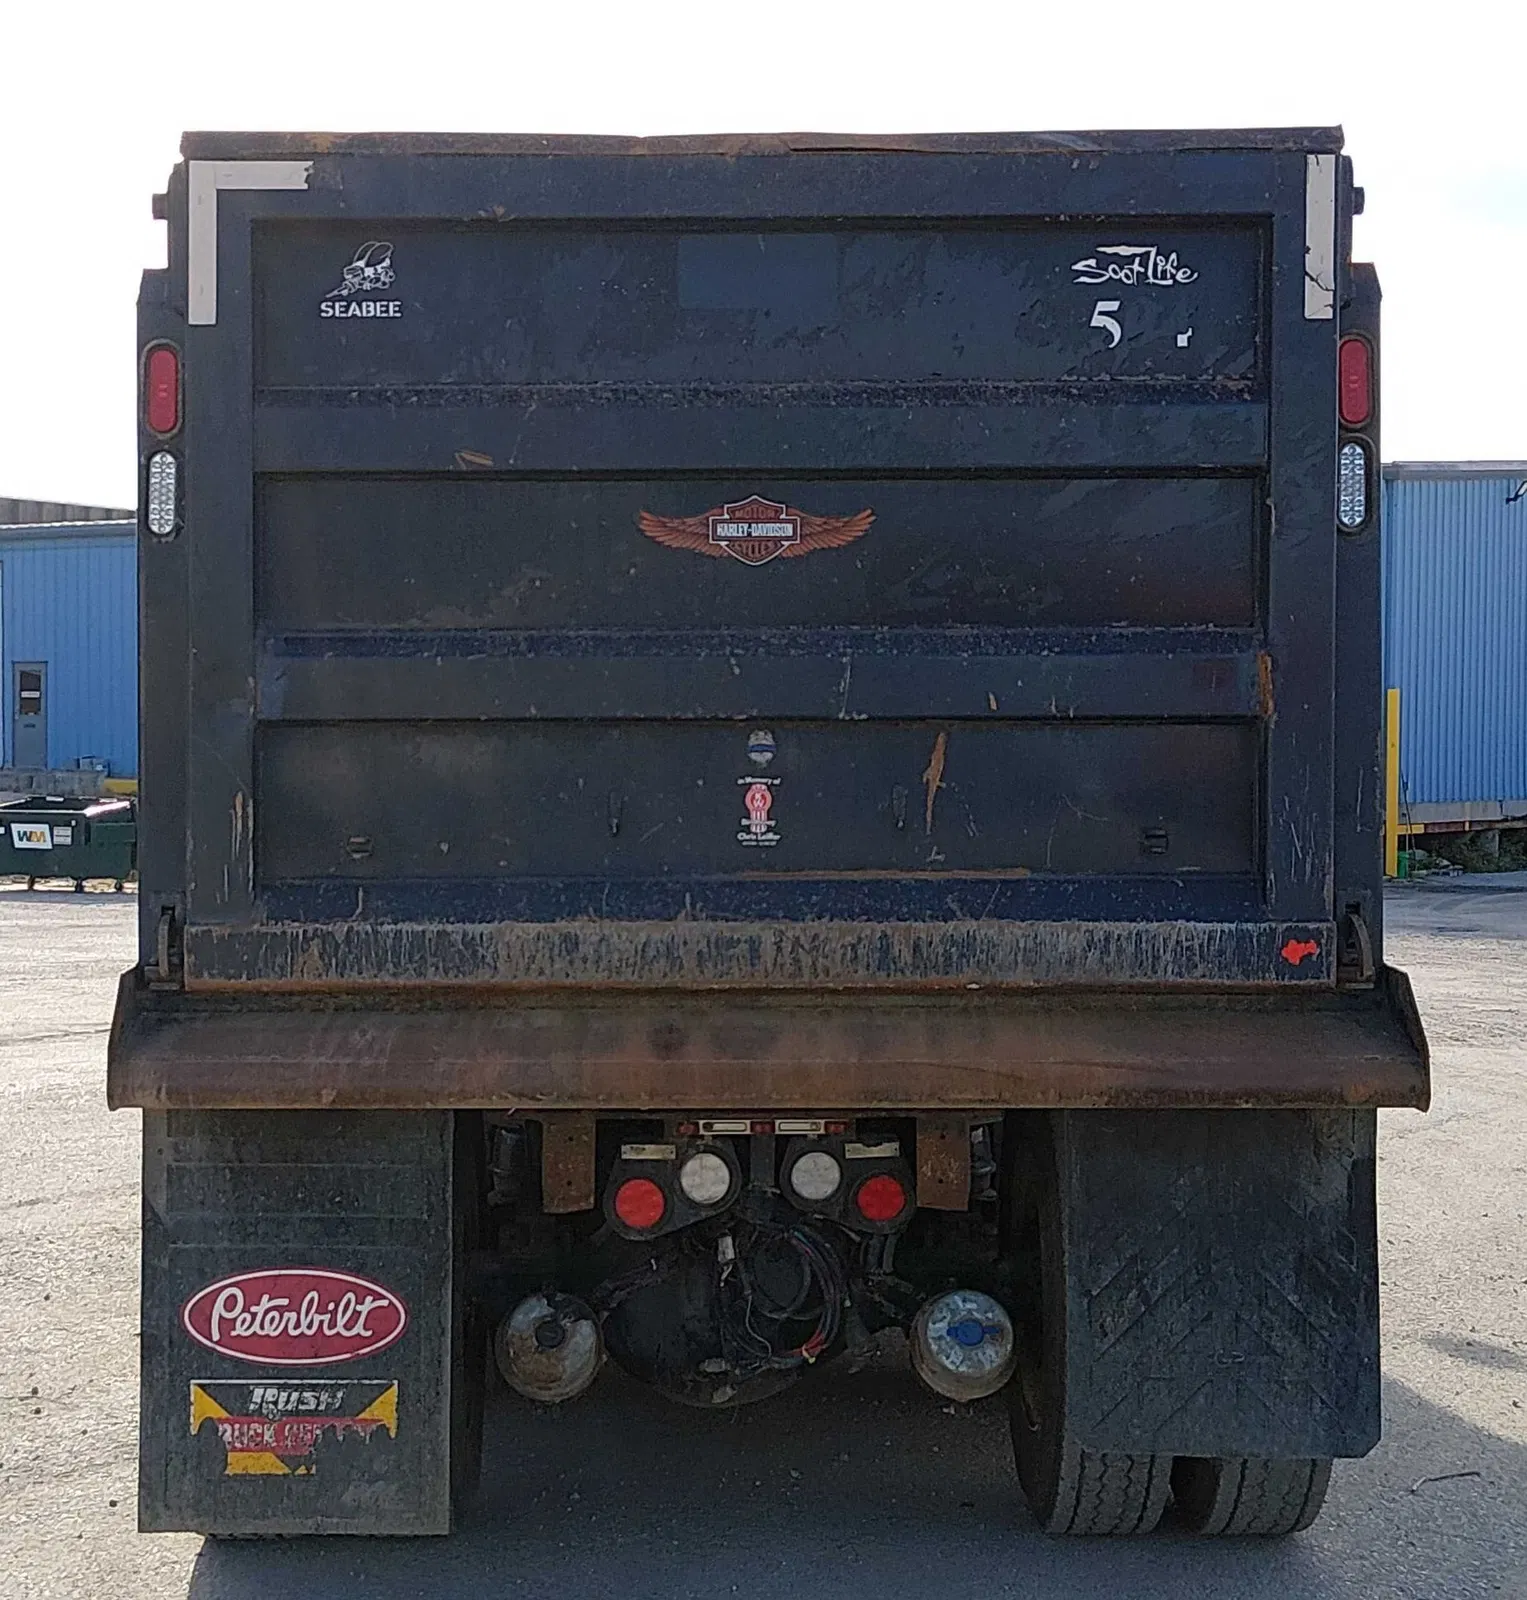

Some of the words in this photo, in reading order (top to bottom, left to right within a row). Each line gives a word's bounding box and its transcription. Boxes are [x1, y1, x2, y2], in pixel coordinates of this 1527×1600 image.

[320, 301, 402, 317] SEABEE
[1089, 300, 1122, 348] 5
[17, 830, 46, 843] WM
[211, 1287, 390, 1342] Peterbilt
[218, 1422, 277, 1448] RUCK
